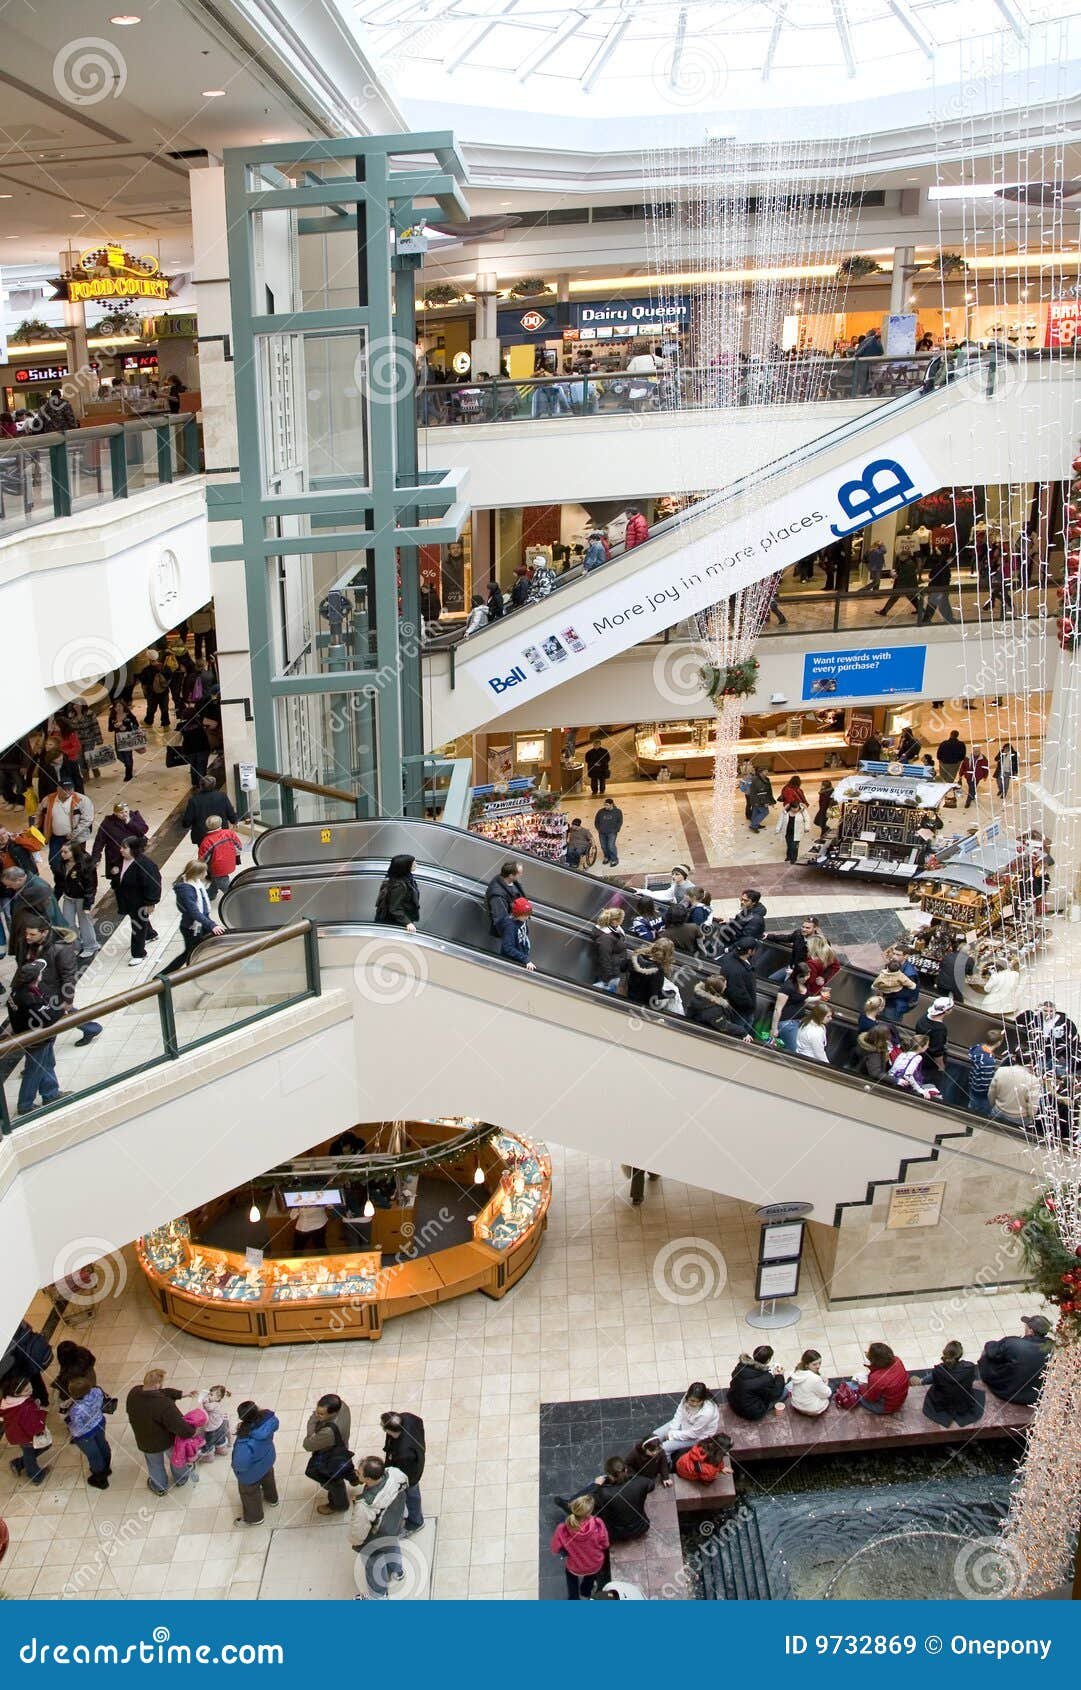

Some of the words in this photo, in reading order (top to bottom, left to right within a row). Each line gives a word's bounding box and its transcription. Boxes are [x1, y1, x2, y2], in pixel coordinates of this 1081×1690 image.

[582, 308, 628, 321] Dairy
[632, 305, 687, 319] Queen
[592, 603, 645, 635] More
[645, 585, 679, 612] joy
[680, 573, 702, 590] in
[706, 545, 755, 578] more
[760, 510, 830, 552] places.
[813, 656, 835, 665] Want
[836, 653, 870, 664] rewards
[872, 652, 892, 660] with
[812, 665, 835, 673] every
[838, 661, 880, 673] purchase?
[488, 666, 527, 694] Bell
[858, 785, 889, 793] UPTOWN
[890, 787, 914, 796] SILVER
